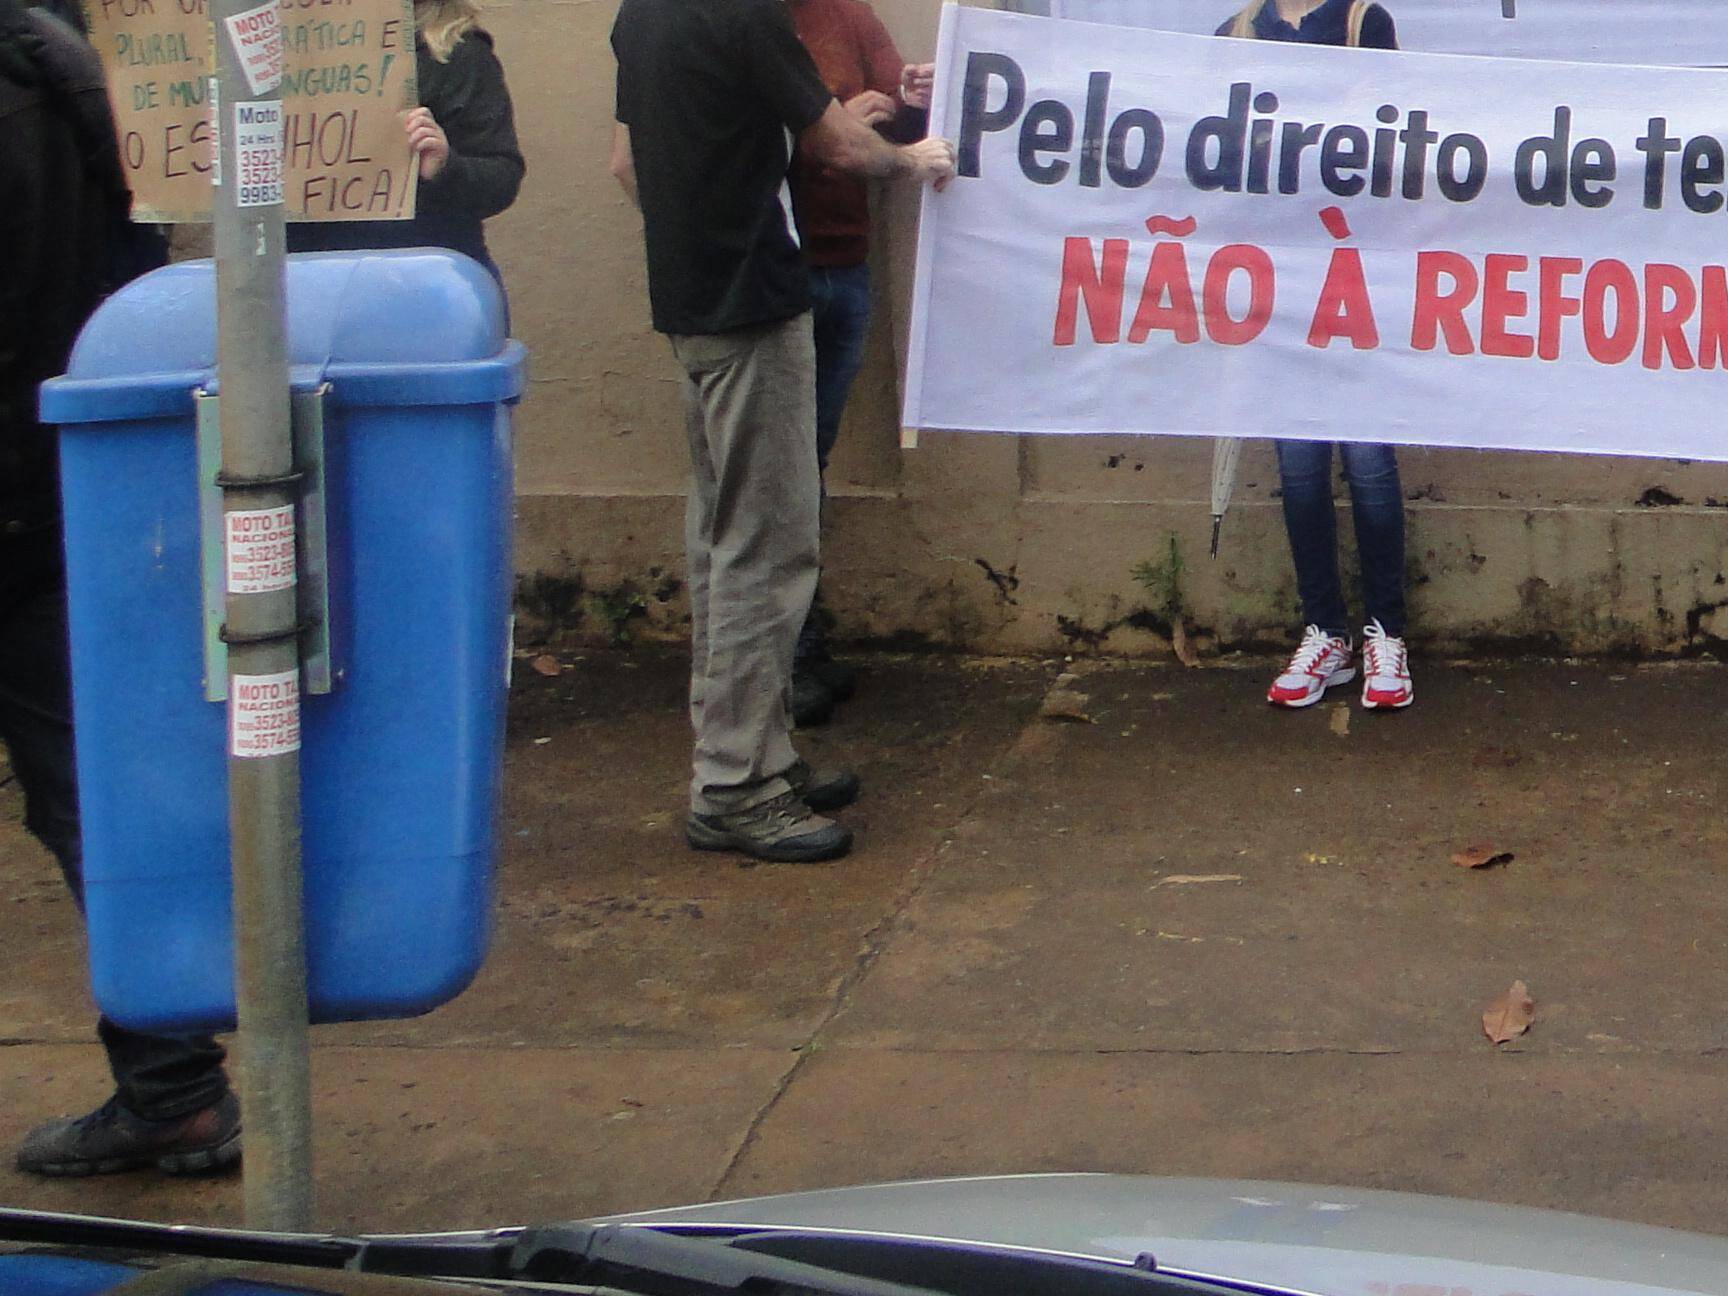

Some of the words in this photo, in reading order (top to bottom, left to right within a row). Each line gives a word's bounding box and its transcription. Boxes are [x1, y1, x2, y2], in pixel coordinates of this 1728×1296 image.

[233, 10, 274, 36] MOTO
[381, 19, 400, 49] E
[132, 81, 159, 112] DE
[239, 107, 279, 125] Moto
[958, 50, 1165, 189] Pelo
[1185, 82, 1488, 203] direito
[1514, 105, 1617, 209] de
[241, 149, 284, 168] 3523-
[242, 167, 284, 185] 3523-
[240, 185, 284, 204] 9983-
[1052, 213, 1276, 347] NÃO
[1306, 205, 1380, 350] À
[232, 515, 272, 532] MOTO
[239, 684, 280, 700] MOTO
